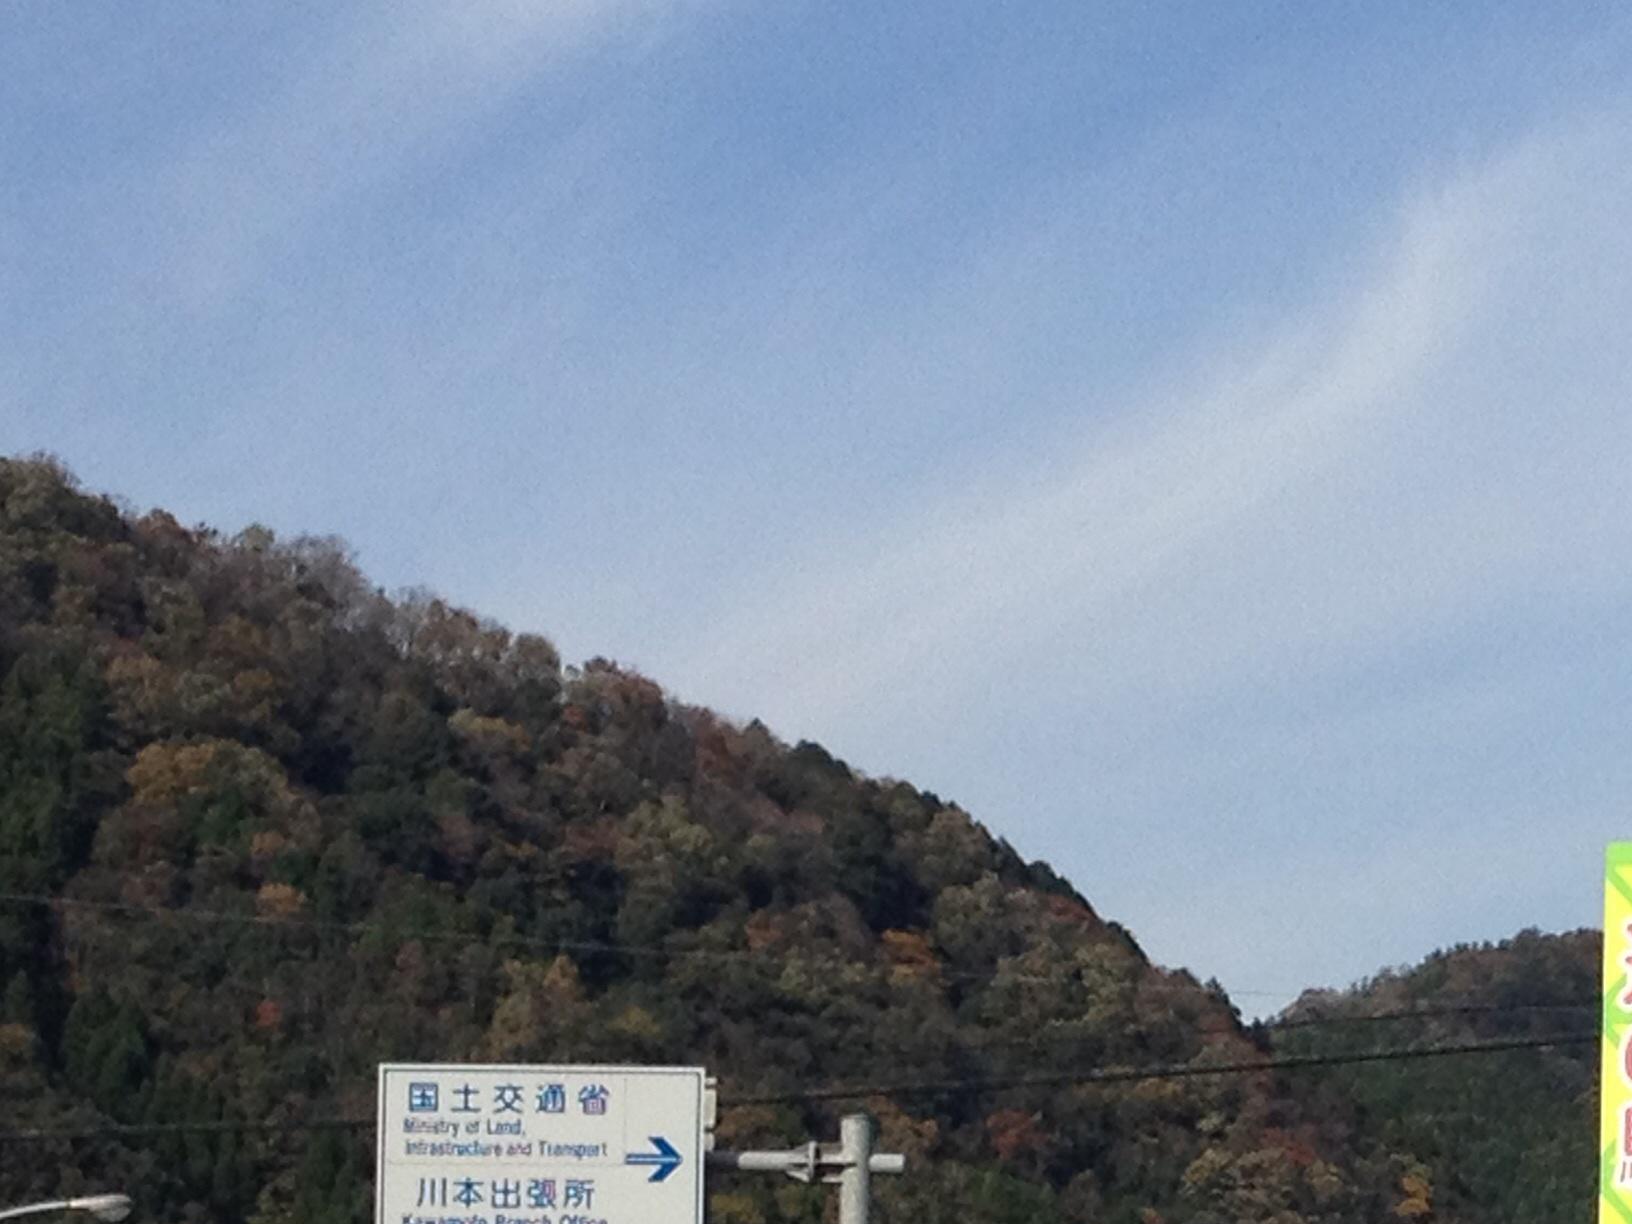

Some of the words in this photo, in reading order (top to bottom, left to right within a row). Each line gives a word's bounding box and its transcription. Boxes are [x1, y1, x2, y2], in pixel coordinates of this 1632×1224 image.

[408, 1081, 610, 1116] 国土交通省
[403, 1117, 460, 1138] Ministry
[465, 1118, 480, 1135] of
[405, 1139, 503, 1157] Infrastructure
[506, 1140, 532, 1157] and
[538, 1139, 608, 1159] Transport
[416, 1177, 595, 1211] 川本出張所
